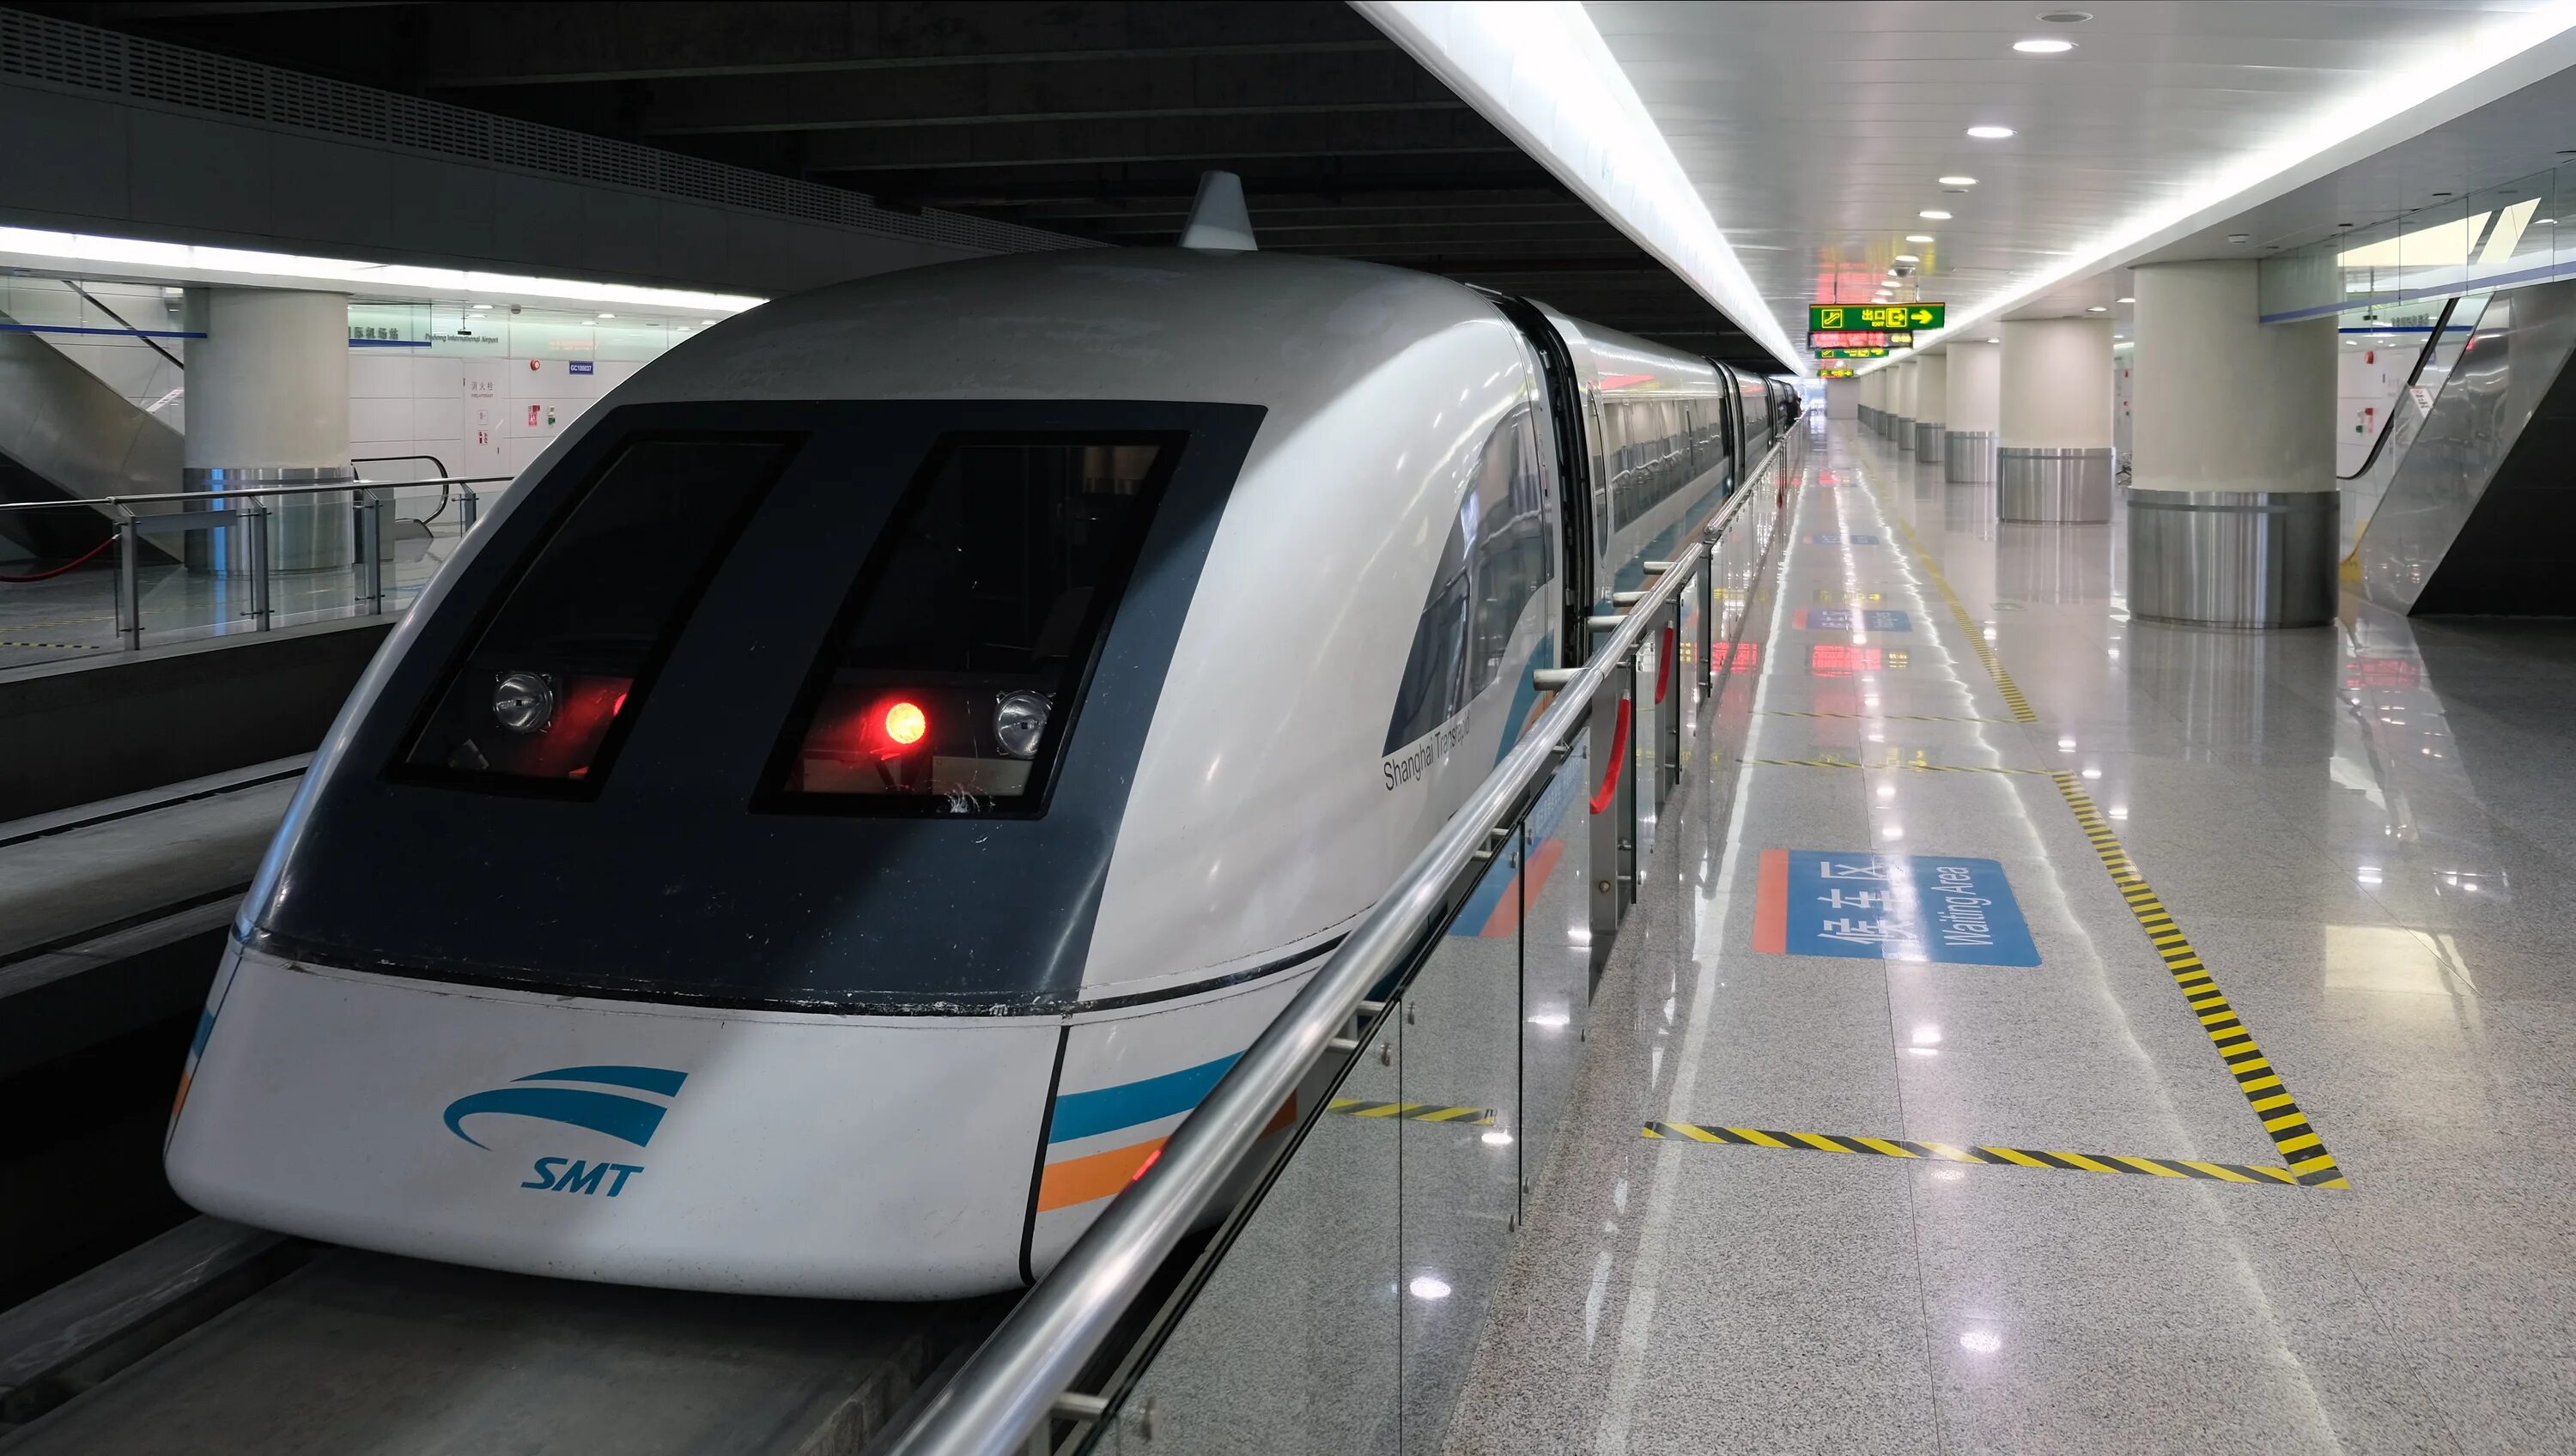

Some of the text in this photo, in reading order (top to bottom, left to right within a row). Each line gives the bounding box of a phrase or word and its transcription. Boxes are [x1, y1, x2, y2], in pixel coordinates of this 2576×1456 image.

[1862, 309, 1885, 321] 出口
[349, 326, 398, 340] 际机场站
[447, 334, 481, 343] International
[482, 336, 499, 344] Airport
[1383, 737, 1433, 791] Shanghai
[1930, 865, 1994, 946] Waiting Area
[520, 1156, 645, 1198] SMT
